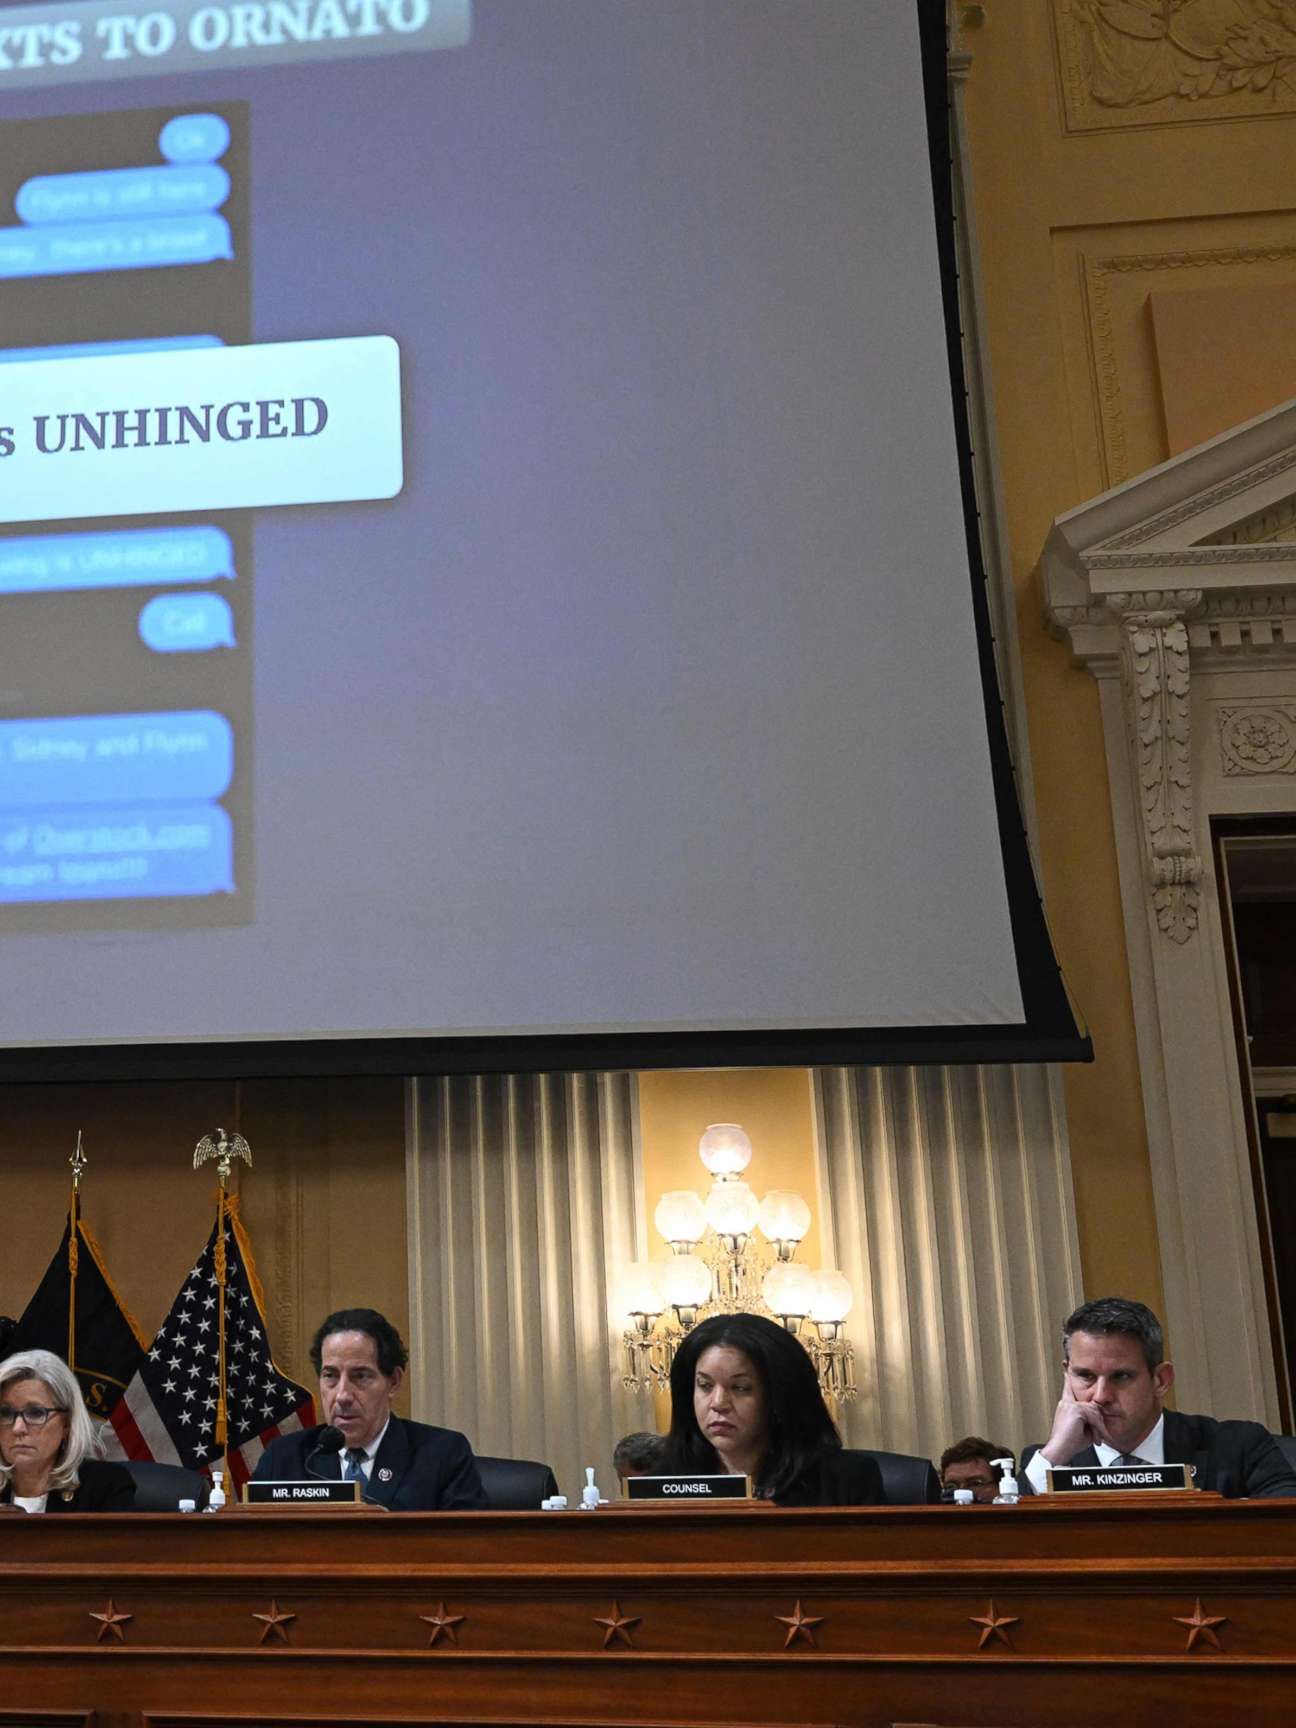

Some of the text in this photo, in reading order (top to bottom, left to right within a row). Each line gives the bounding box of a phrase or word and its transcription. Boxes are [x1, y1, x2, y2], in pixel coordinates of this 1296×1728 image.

[96, 12, 177, 62] TO
[188, 0, 430, 52] ORNATO
[32, 396, 329, 454] UNHINGED
[1071, 1472, 1163, 1486] MR. KINZINGER
[272, 1487, 330, 1498] MR. RASKIN
[662, 1483, 712, 1494] COUNSEL
